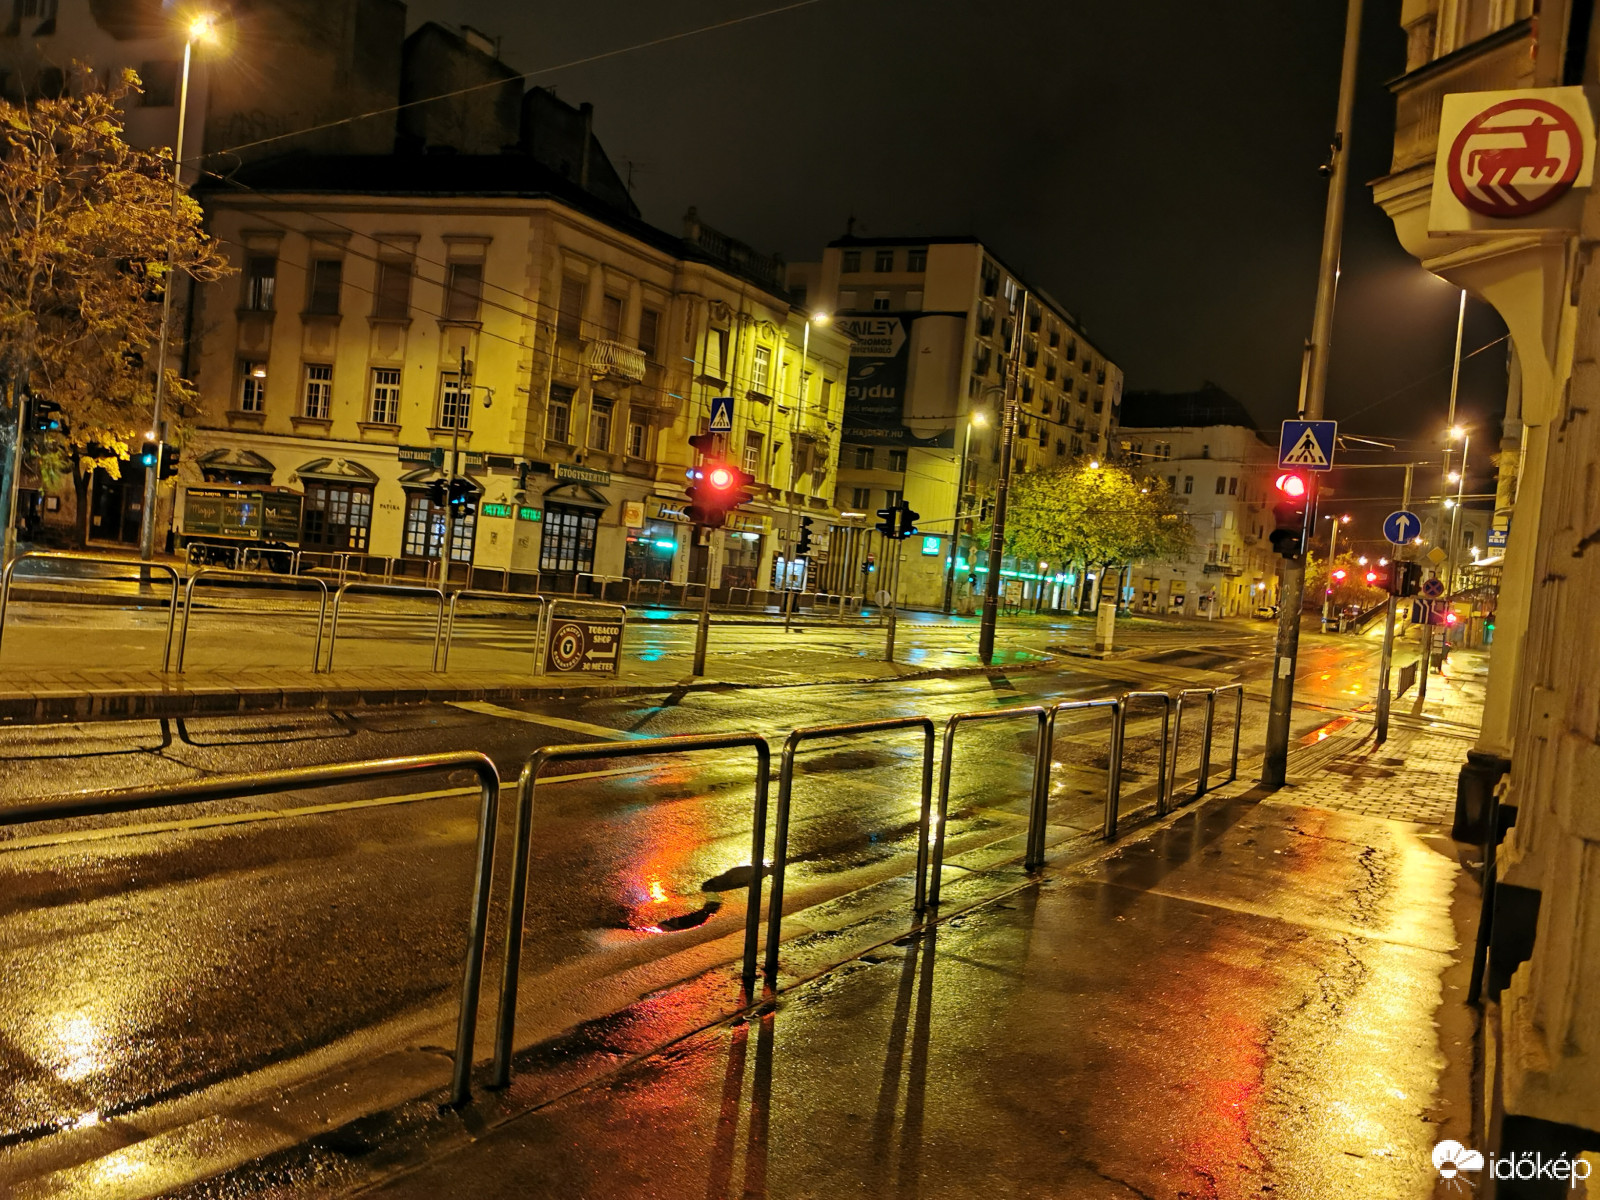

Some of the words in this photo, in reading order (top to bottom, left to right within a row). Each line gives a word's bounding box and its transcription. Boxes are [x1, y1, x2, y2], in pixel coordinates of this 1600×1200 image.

[656, 502, 690, 522] BÉC
[588, 626, 619, 635] TOBACCO
[593, 635, 612, 643] SHOP
[565, 643, 572, 652] T
